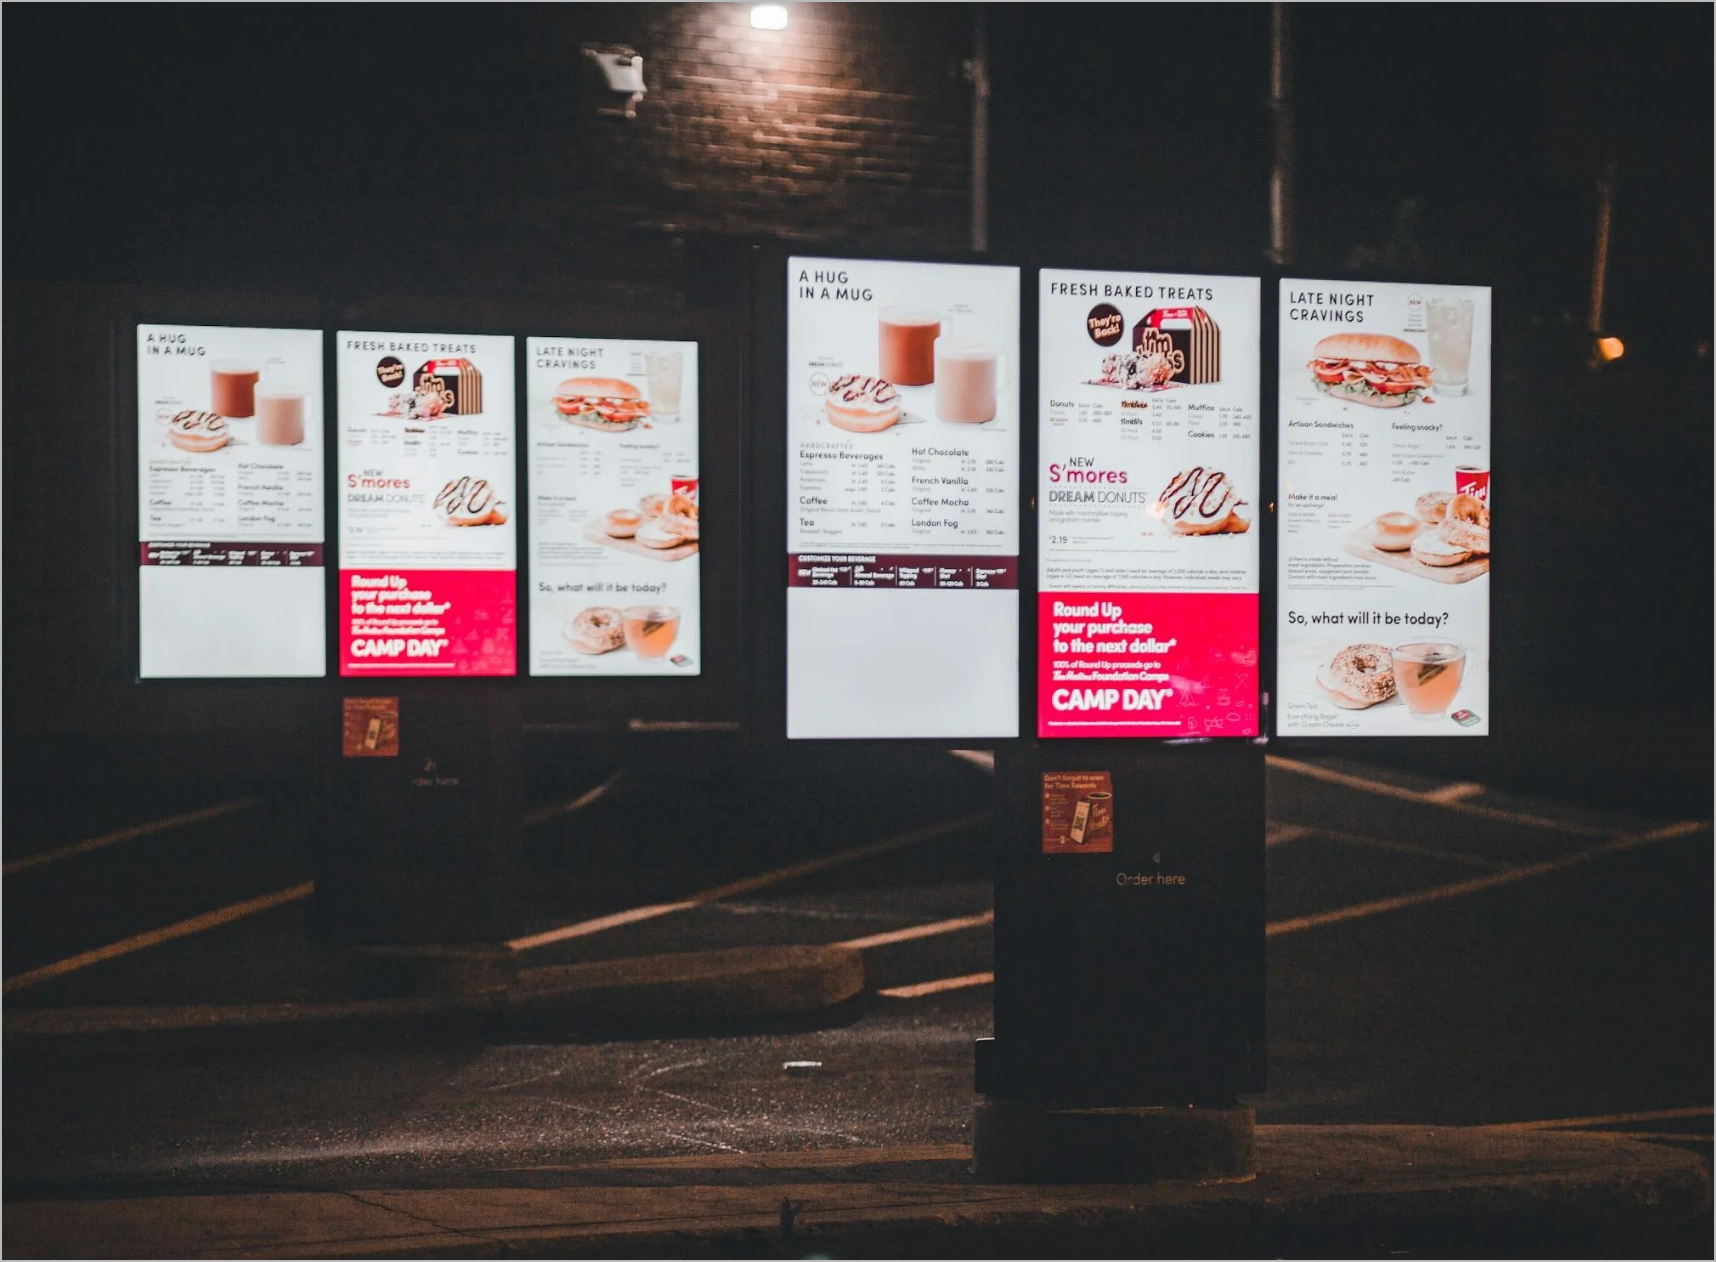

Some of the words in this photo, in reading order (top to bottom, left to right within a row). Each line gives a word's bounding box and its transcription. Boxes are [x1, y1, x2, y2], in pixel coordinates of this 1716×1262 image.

[799, 270, 809, 283] A
[814, 270, 849, 284] HUG
[799, 286, 815, 300] IN
[820, 287, 831, 300] A
[836, 288, 873, 302] MUG
[1051, 282, 1098, 297] FRESH
[1104, 284, 1153, 299] BAKED
[1158, 286, 1214, 301] TREATS
[1290, 291, 1324, 305] LATE
[1329, 293, 1374, 307] NIGHT
[1290, 308, 1364, 323] CRAVINGS
[1088, 314, 1122, 330] They're
[1094, 324, 1120, 339] Back!
[147, 333, 155, 343] A
[159, 333, 187, 344] HUG
[147, 345, 160, 355] IN
[164, 346, 173, 356] A
[176, 346, 206, 357] MUG
[347, 340, 385, 351] FRESH
[389, 342, 429, 353] BAKED
[430, 343, 476, 354] TREATS
[536, 347, 564, 357] LATE
[568, 348, 604, 358] NIGHT
[536, 358, 597, 370] CRAVINGS
[1050, 399, 1075, 408] Donuts
[1288, 420, 1313, 428] Artisan
[1314, 421, 1354, 429] Sandwiches
[1391, 422, 1416, 432] Feeling
[1417, 423, 1443, 432] snacky?
[1187, 430, 1215, 439] Cookies
[800, 442, 855, 450] HANDCRAFTED
[911, 447, 926, 456] Hot
[928, 447, 970, 457] Chocolate
[800, 450, 837, 460] Espresso
[839, 451, 884, 462] Beverages
[1069, 456, 1095, 468] NEW
[363, 468, 384, 477] NEW
[1049, 463, 1128, 484] S'mores
[347, 473, 411, 489] S'mores
[911, 476, 940, 485] French
[941, 476, 969, 485] Vanilla
[347, 493, 385, 503] DREAM
[800, 496, 828, 505] Coffee
[911, 496, 939, 506] Coffee
[941, 498, 970, 506] Mocha
[1048, 490, 1095, 503] DREAM
[1288, 493, 1307, 501] Make
[800, 518, 815, 527] Tea
[911, 518, 942, 527] London
[943, 519, 958, 529] Fog
[798, 554, 831, 563] CUSTOMIZE
[831, 555, 847, 563] YOUR
[847, 555, 876, 564] BEVERAGE
[538, 582, 554, 593] So,
[557, 582, 583, 592] what
[586, 582, 604, 592] will
[606, 583, 613, 592] it
[616, 582, 628, 592] be
[632, 582, 667, 594] today?
[1053, 600, 1099, 617] Round
[1101, 601, 1122, 621] Up
[1288, 611, 1308, 626] So,
[1312, 611, 1344, 625] what
[1348, 612, 1369, 625] will
[1372, 612, 1381, 625] it
[1385, 612, 1402, 625] be
[1404, 612, 1449, 629] today?
[1053, 622, 1086, 639] your
[1087, 618, 1153, 639] purchase
[350, 638, 406, 658] CAMP
[1053, 638, 1069, 653] to
[1070, 637, 1095, 653] the
[1096, 638, 1128, 653] next
[1070, 660, 1079, 669] of
[1079, 660, 1101, 669] Round
[1101, 660, 1111, 670] Up
[1112, 660, 1143, 670] proceeds
[1144, 662, 1153, 671] go
[1153, 661, 1161, 669] to
[1093, 671, 1139, 681] Foundation
[1139, 671, 1170, 683] Camps
[1051, 688, 1120, 712] CAMP
[1116, 872, 1154, 886] Order
[1156, 872, 1186, 886] here
